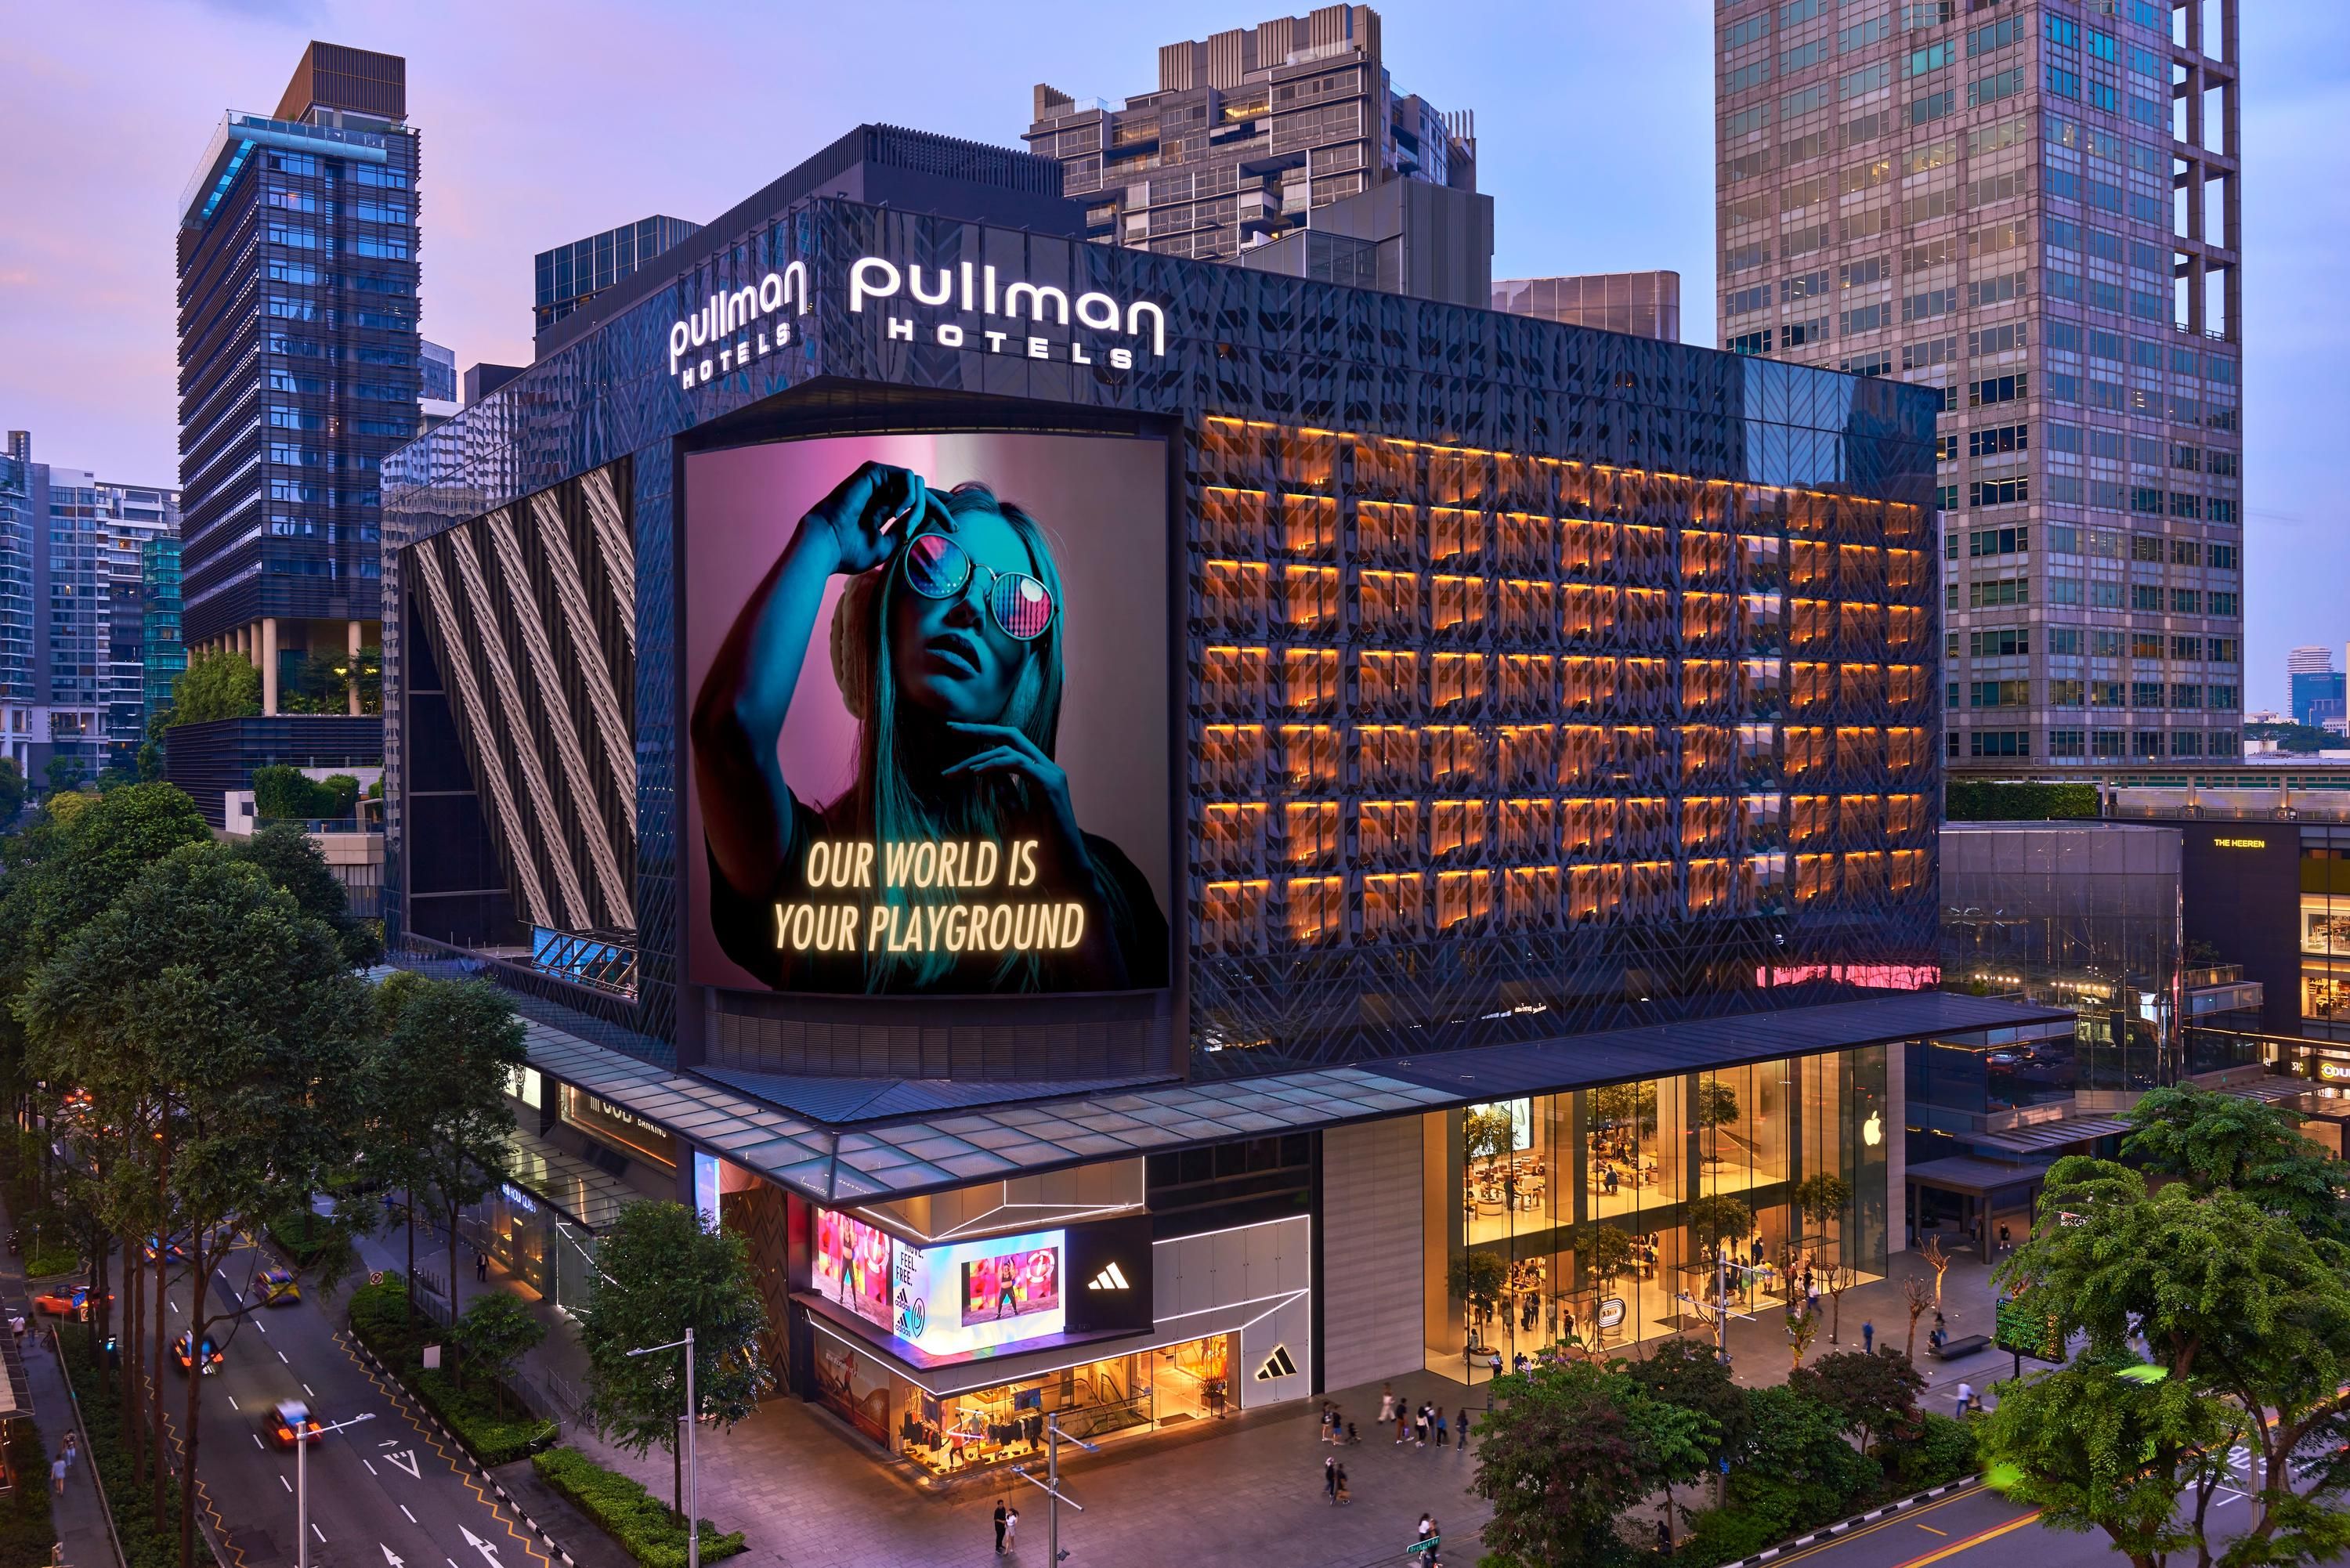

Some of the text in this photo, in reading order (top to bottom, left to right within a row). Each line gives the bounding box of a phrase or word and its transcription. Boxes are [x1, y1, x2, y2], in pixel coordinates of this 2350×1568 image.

[851, 257, 1165, 356] pullman
[670, 260, 808, 376] pullman
[888, 317, 1133, 370] HOTELS
[682, 322, 790, 390] HOTELS
[2231, 840, 2265, 848] HEEREN
[808, 840, 1039, 888] OUR WORLD IS
[775, 902, 1084, 952] YOUR PLAYGROUND
[2323, 1064, 2350, 1078] COU
[901, 1252, 916, 1272] FEEL.
[896, 1265, 913, 1286] FREE.
[895, 1299, 911, 1312] adidas
[895, 1324, 911, 1337] adidas
[1410, 1541, 1431, 1552] Orchard
